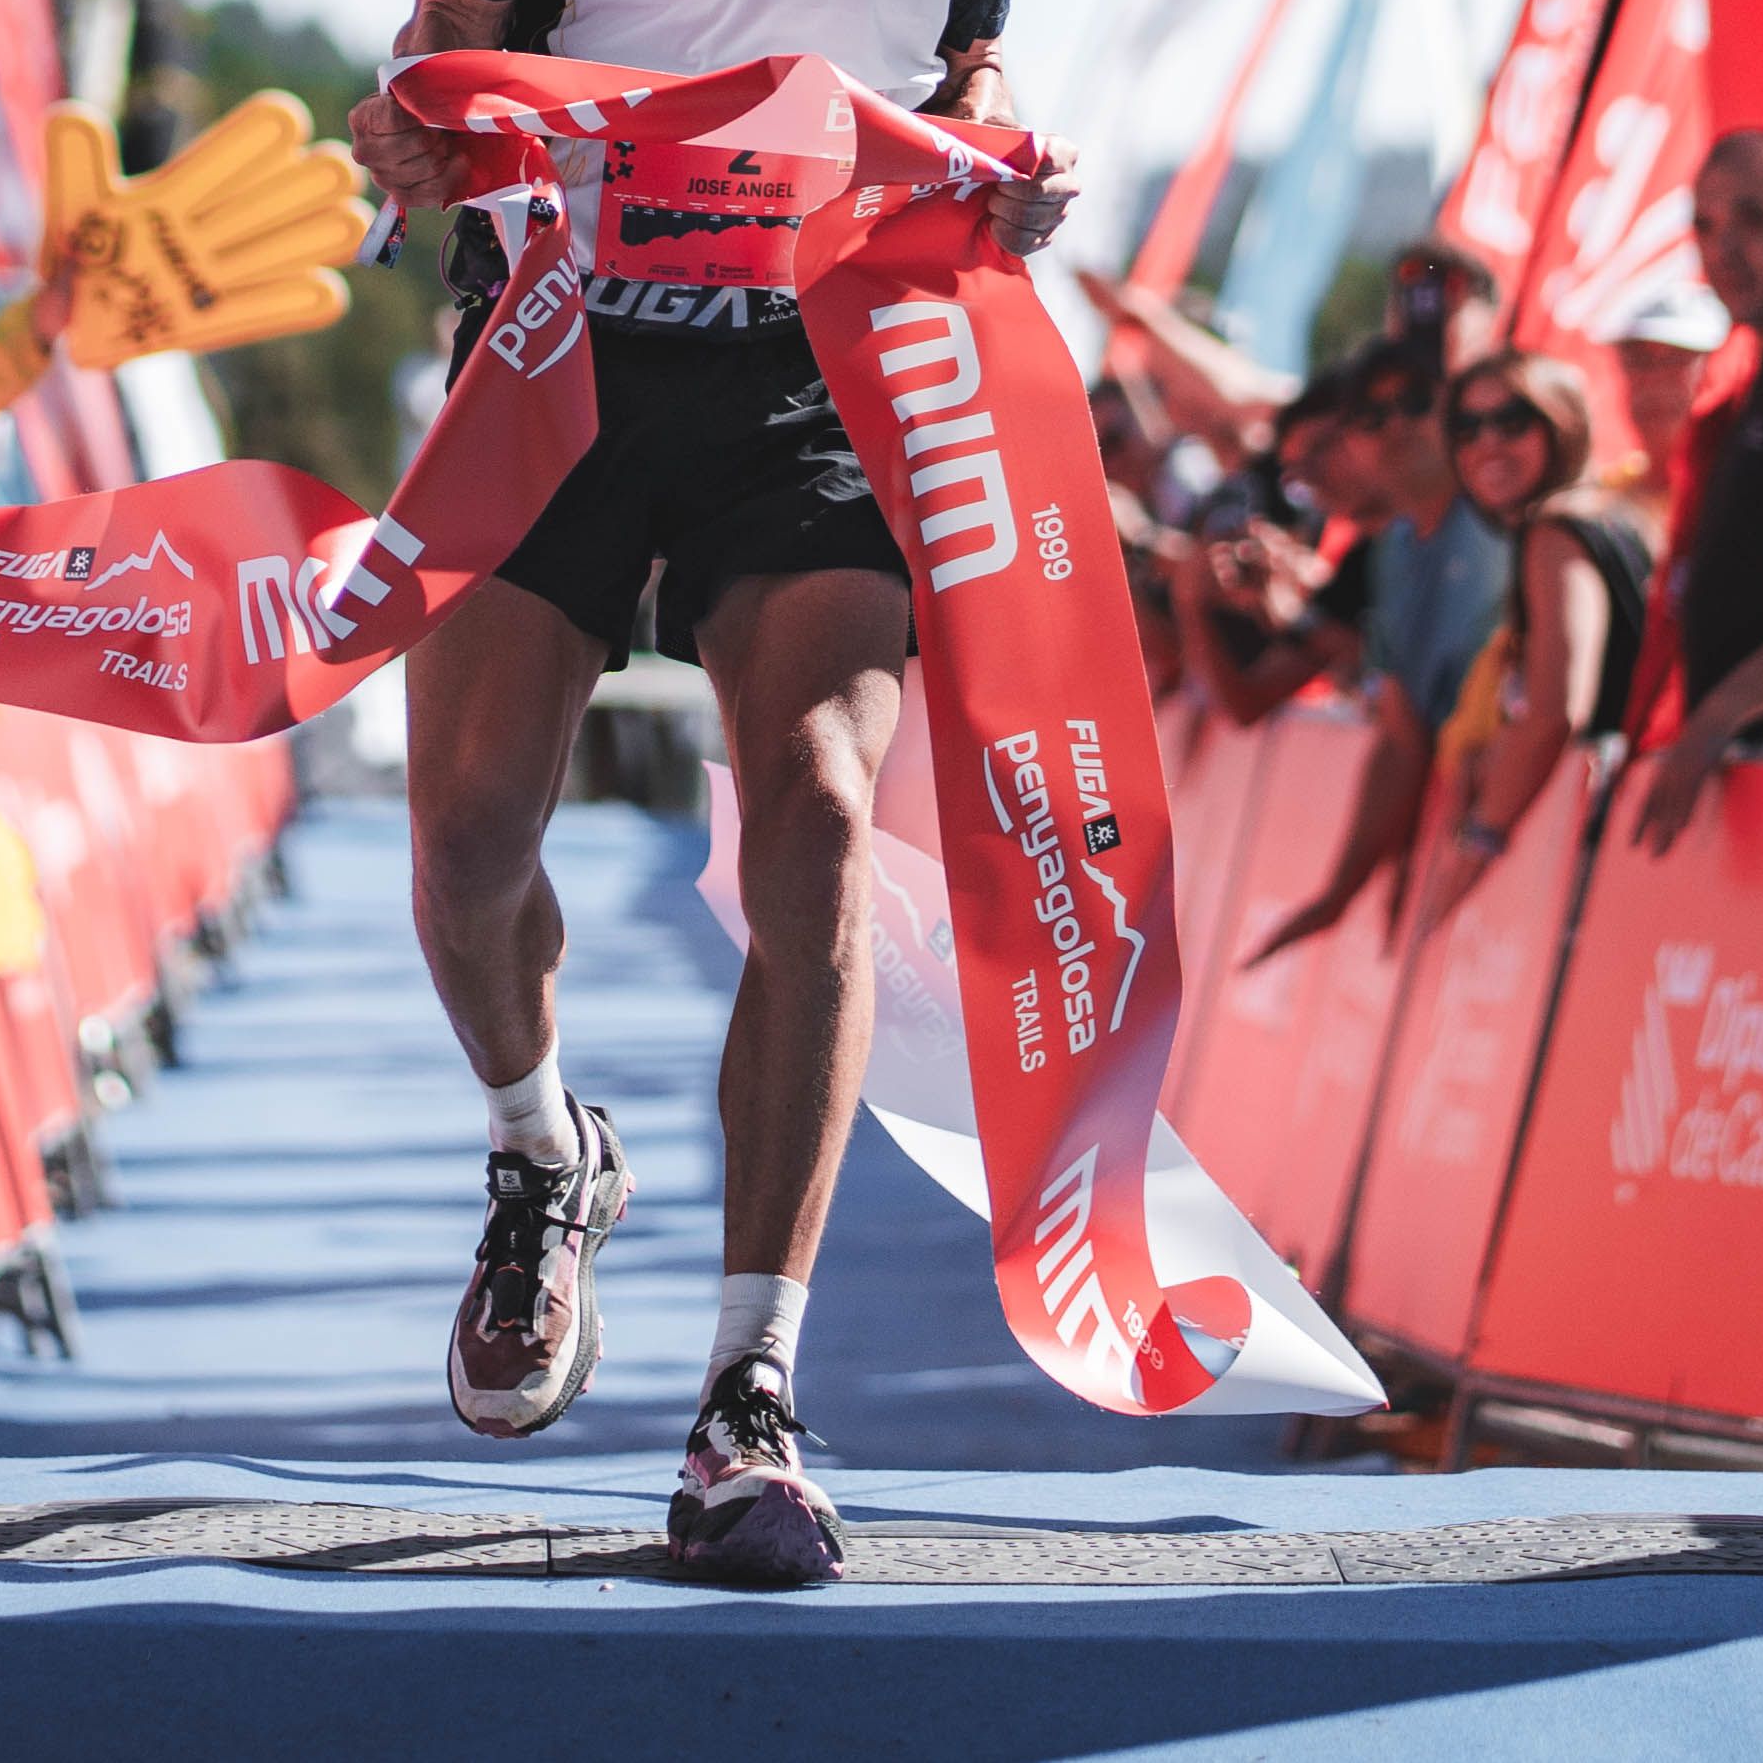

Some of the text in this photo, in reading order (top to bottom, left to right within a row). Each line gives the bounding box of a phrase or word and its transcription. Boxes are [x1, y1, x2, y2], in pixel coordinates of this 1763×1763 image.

[687, 178, 796, 198] JOSE ANGEL
[586, 277, 800, 328] UGA KAILA
[1031, 504, 1073, 581] 1999
[98, 649, 189, 692] TRAILS
[1066, 718, 1111, 821] FUGA
[995, 730, 1096, 1054] penyagolosa
[1009, 969, 1046, 1073] TRAILS
